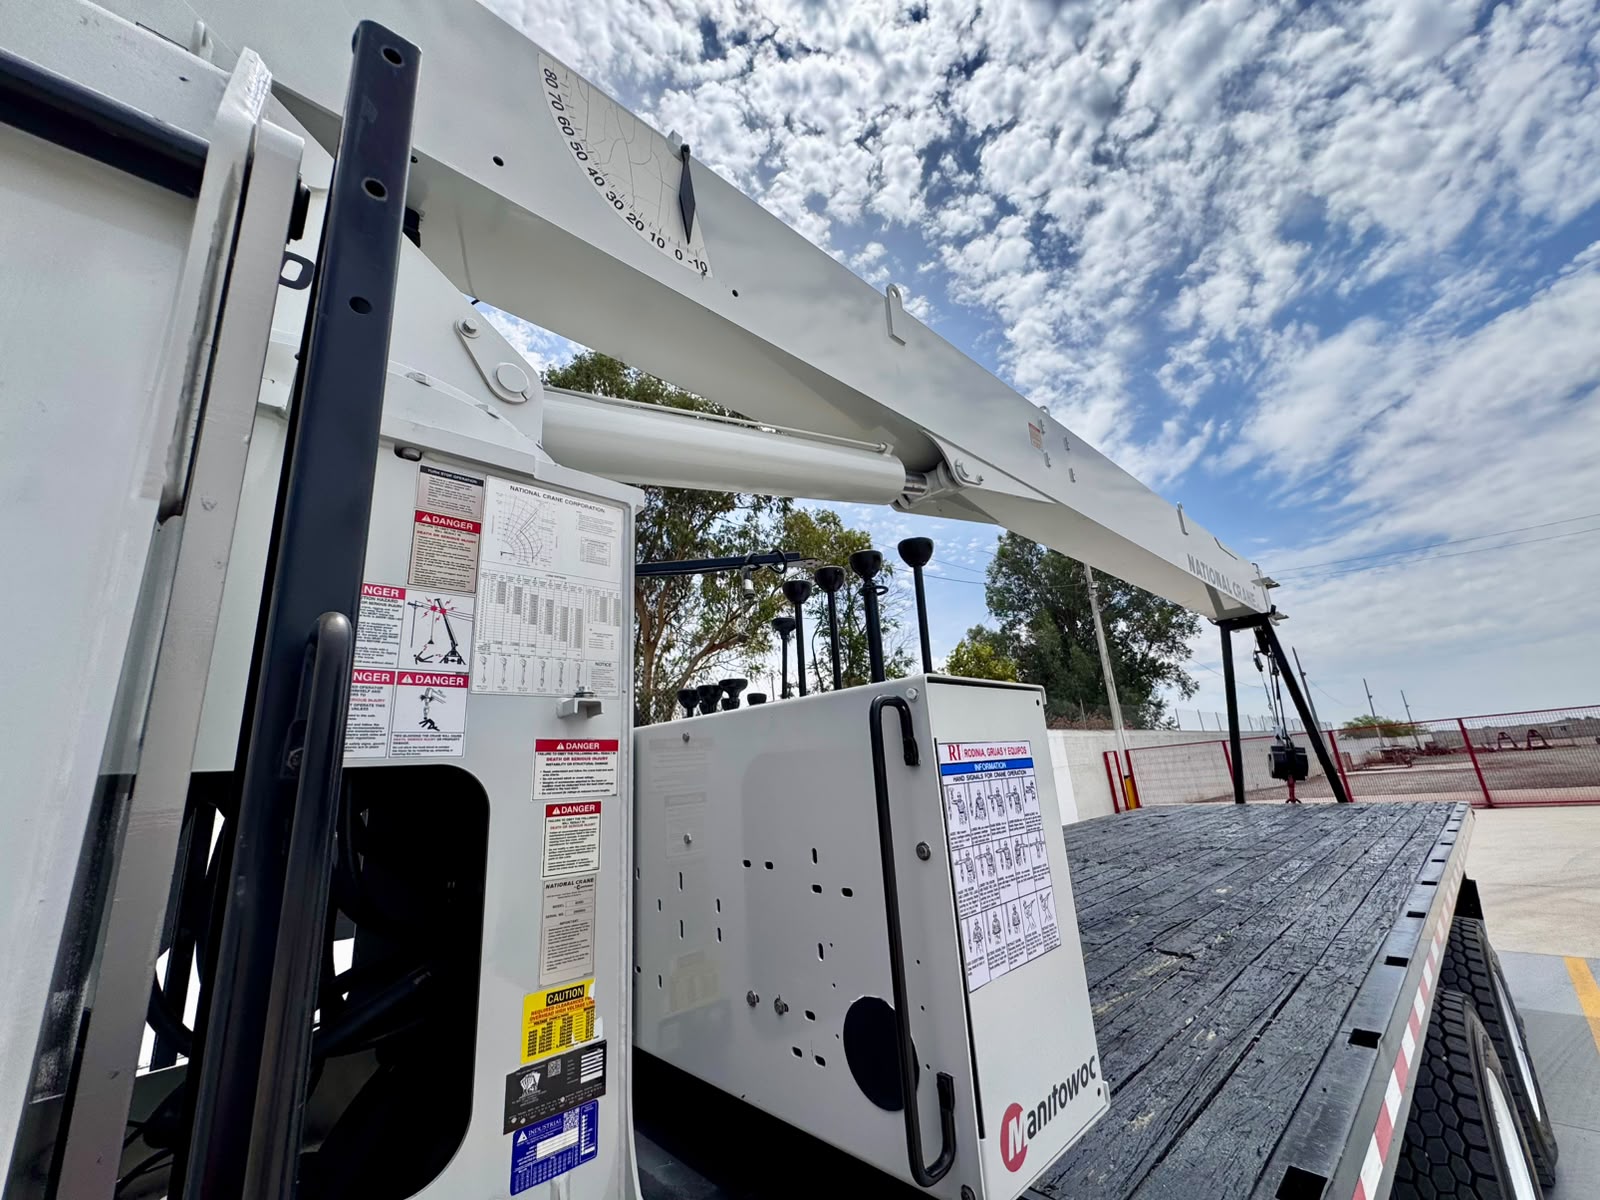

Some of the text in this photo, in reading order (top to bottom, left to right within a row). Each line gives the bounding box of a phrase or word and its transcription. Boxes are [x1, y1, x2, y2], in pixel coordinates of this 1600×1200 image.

[543, 67, 558, 89] 80
[548, 91, 564, 111] 70
[558, 115, 574, 137] 60
[570, 140, 588, 161] 50
[587, 166, 605, 186] 40
[605, 191, 624, 210] 30
[626, 212, 644, 232] 20
[650, 232, 665, 248] 10
[674, 248, 683, 260] 0
[688, 258, 708, 274] -10
[510, 485, 606, 513] NATIONAL CRANE CORPORATION
[432, 516, 473, 530] DANGER
[1187, 553, 1257, 605] NATIONAL CRANE
[364, 585, 400, 598] NGER
[353, 672, 390, 682] NGER
[415, 675, 464, 686] DANGER
[974, 762, 1007, 771] INFORMATION
[561, 804, 595, 814] DANGER
[546, 881, 574, 889] NATIONAL
[548, 986, 584, 1004] CAUTION
[1000, 1055, 1096, 1173] Manitowoc
